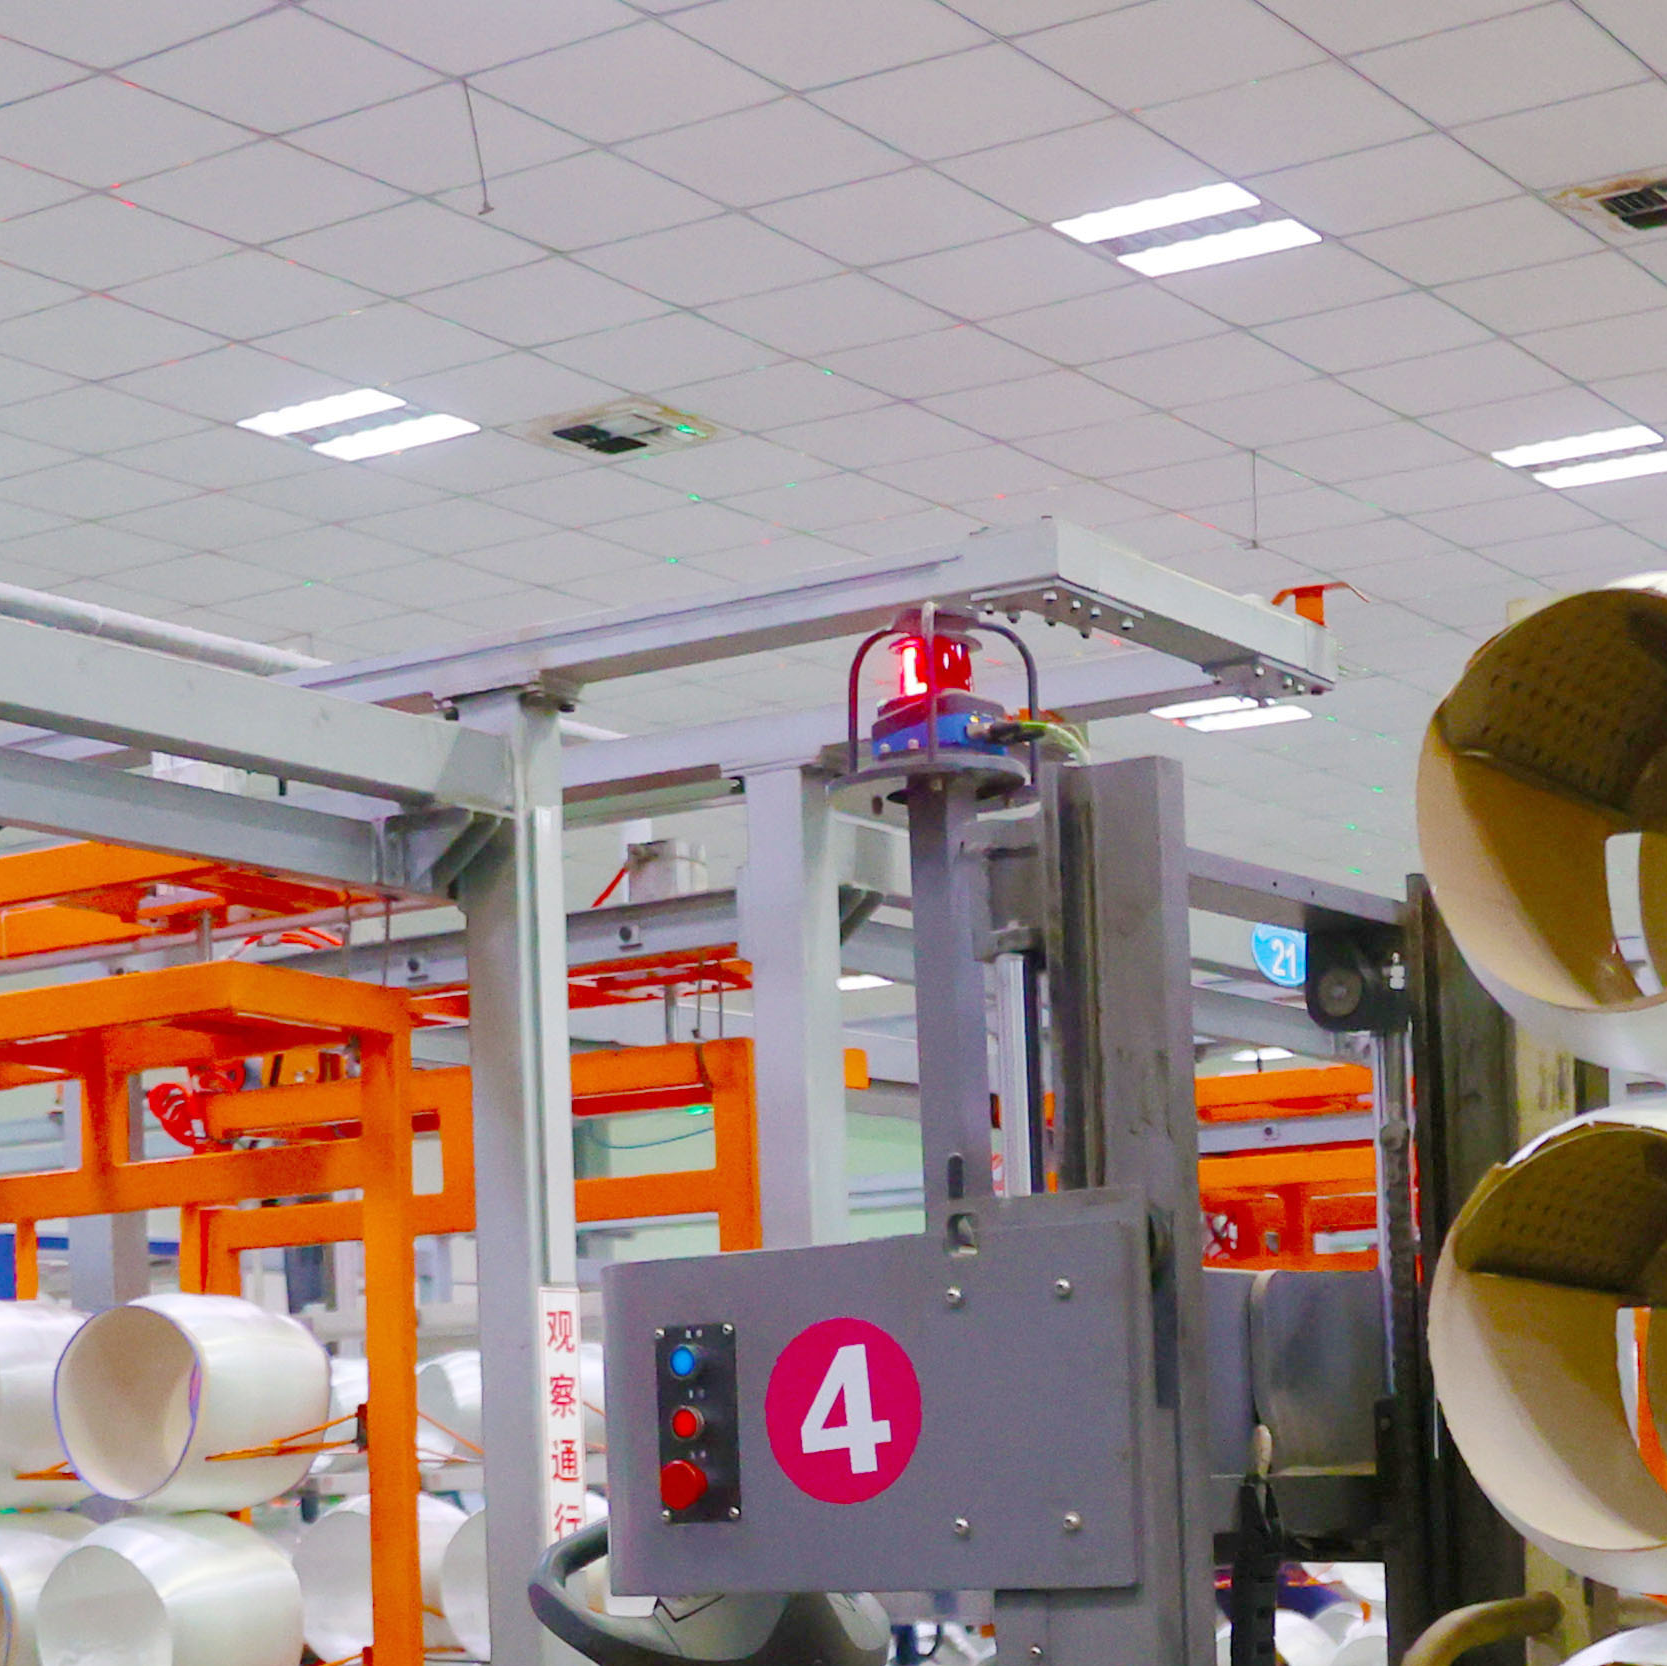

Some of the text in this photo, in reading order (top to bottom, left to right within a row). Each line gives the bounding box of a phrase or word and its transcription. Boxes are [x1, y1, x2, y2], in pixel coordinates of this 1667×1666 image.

[1272, 938, 1296, 979] 21
[546, 1310, 582, 1541] 观察通行
[800, 1343, 892, 1475] 4
